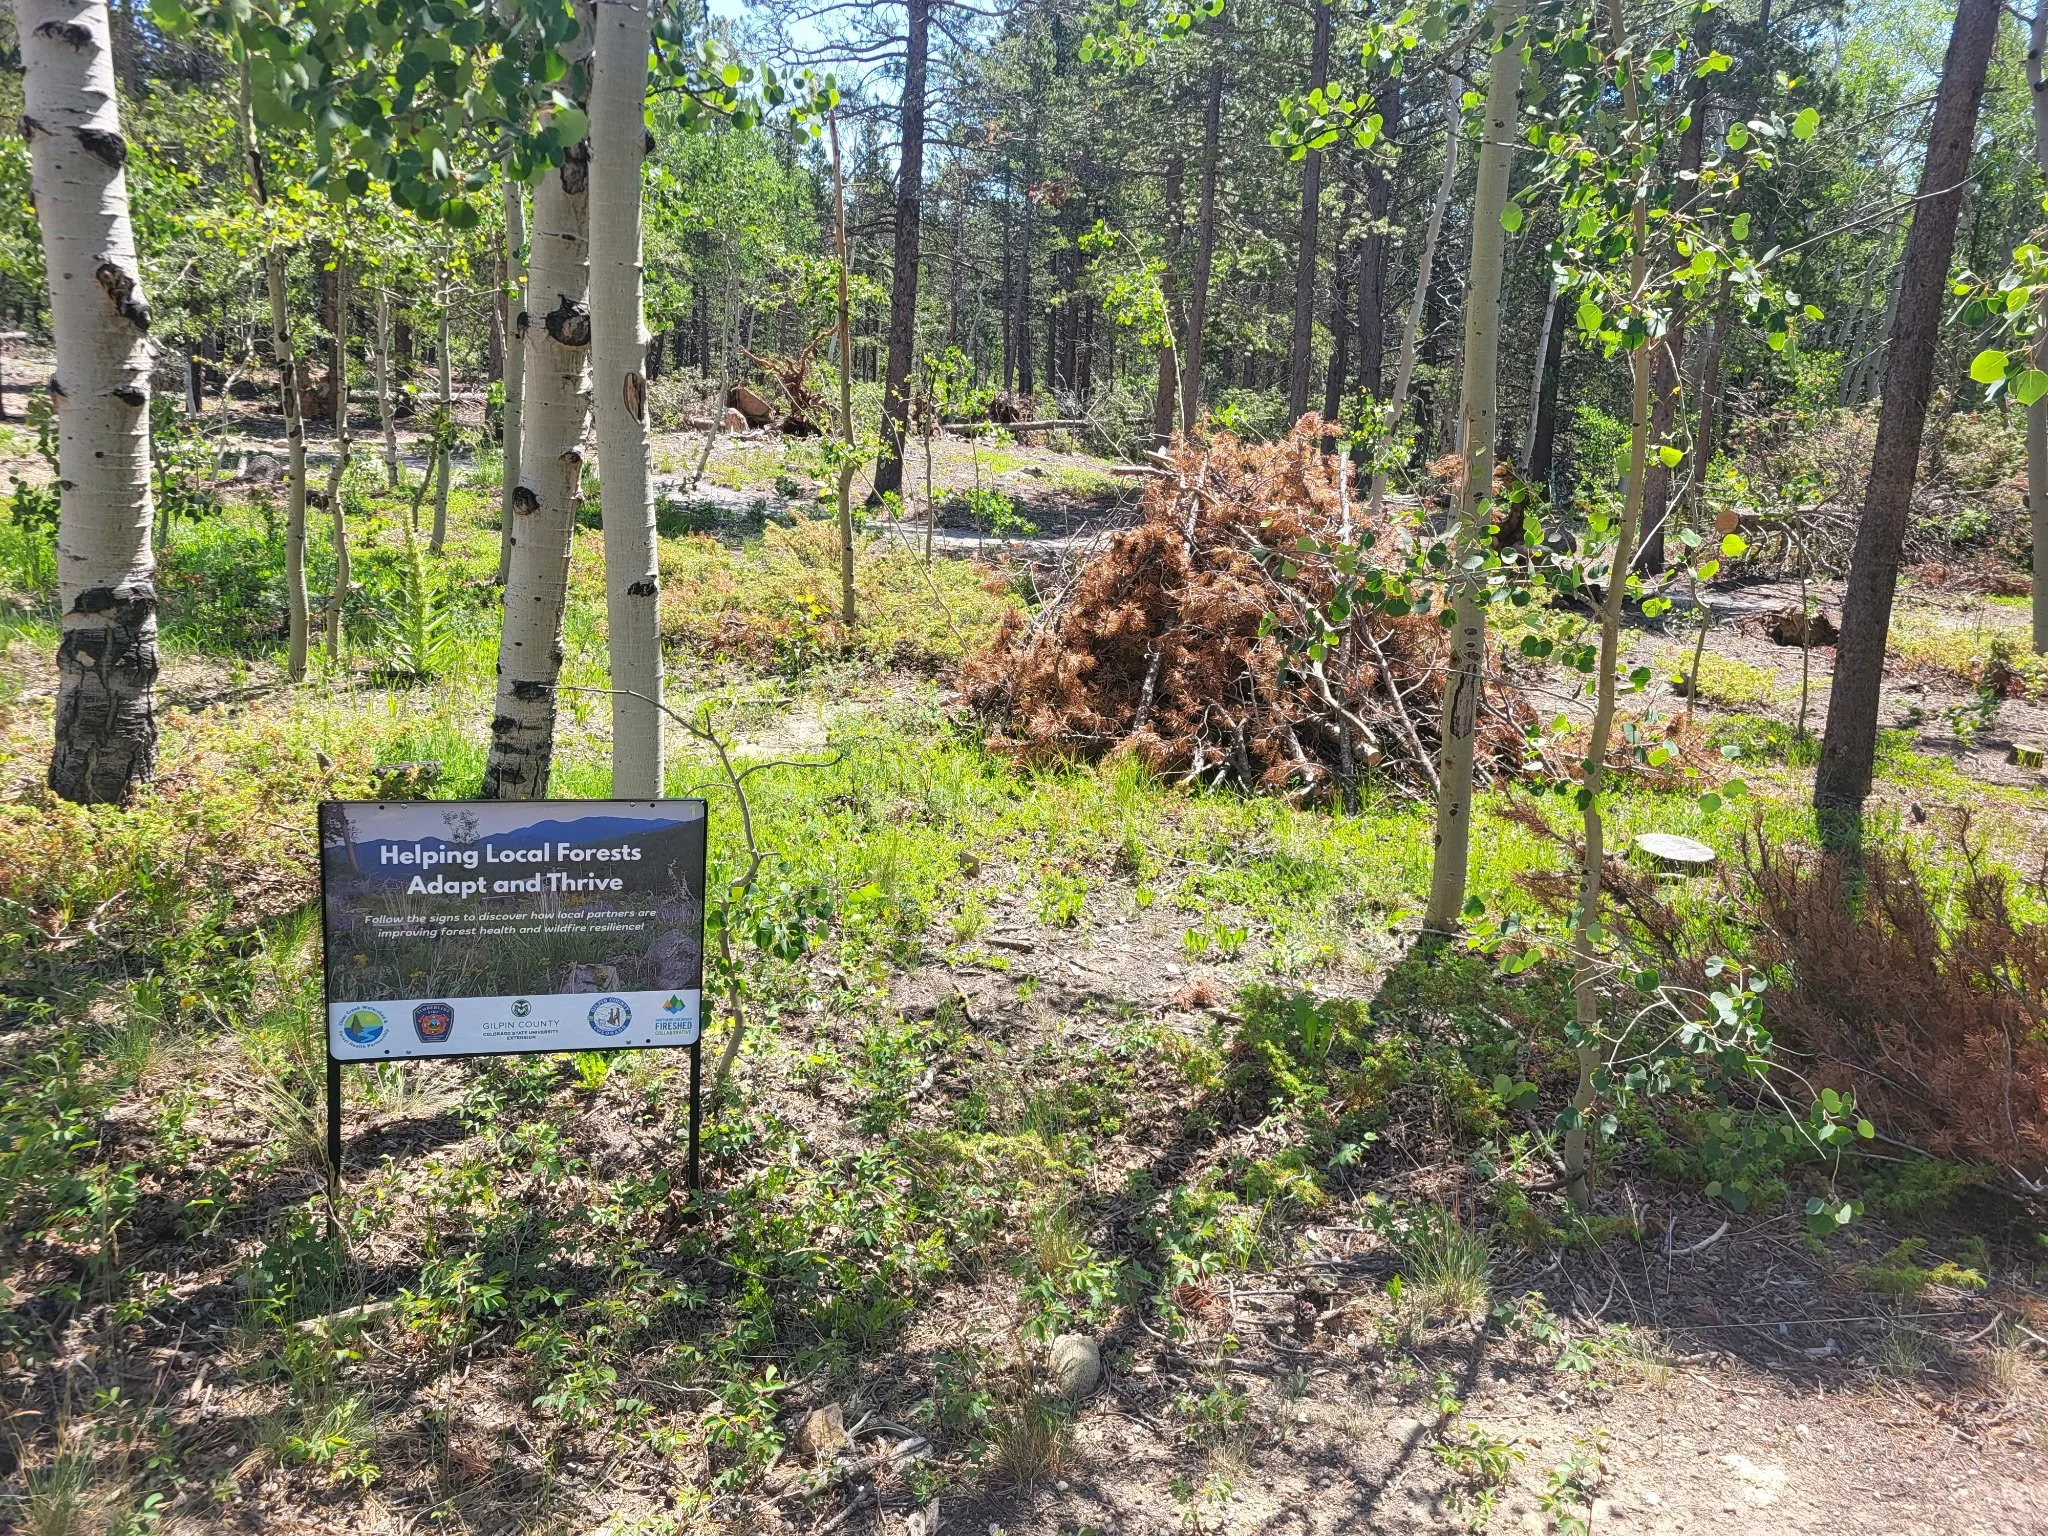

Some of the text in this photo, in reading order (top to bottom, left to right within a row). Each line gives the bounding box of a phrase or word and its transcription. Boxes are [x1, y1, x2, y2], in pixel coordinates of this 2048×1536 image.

[380, 842, 642, 869] Helping Local Forests
[406, 872, 624, 899] Adapt and Thrive
[364, 909, 657, 925] Follow the signs to discover how local partners are
[377, 922, 645, 940] improving forest health and wildfire resilience!
[482, 1020, 560, 1030] GILPIN COUNTY
[593, 1025, 627, 1036] COLORADO
[655, 1021, 693, 1031] FIRESHED
